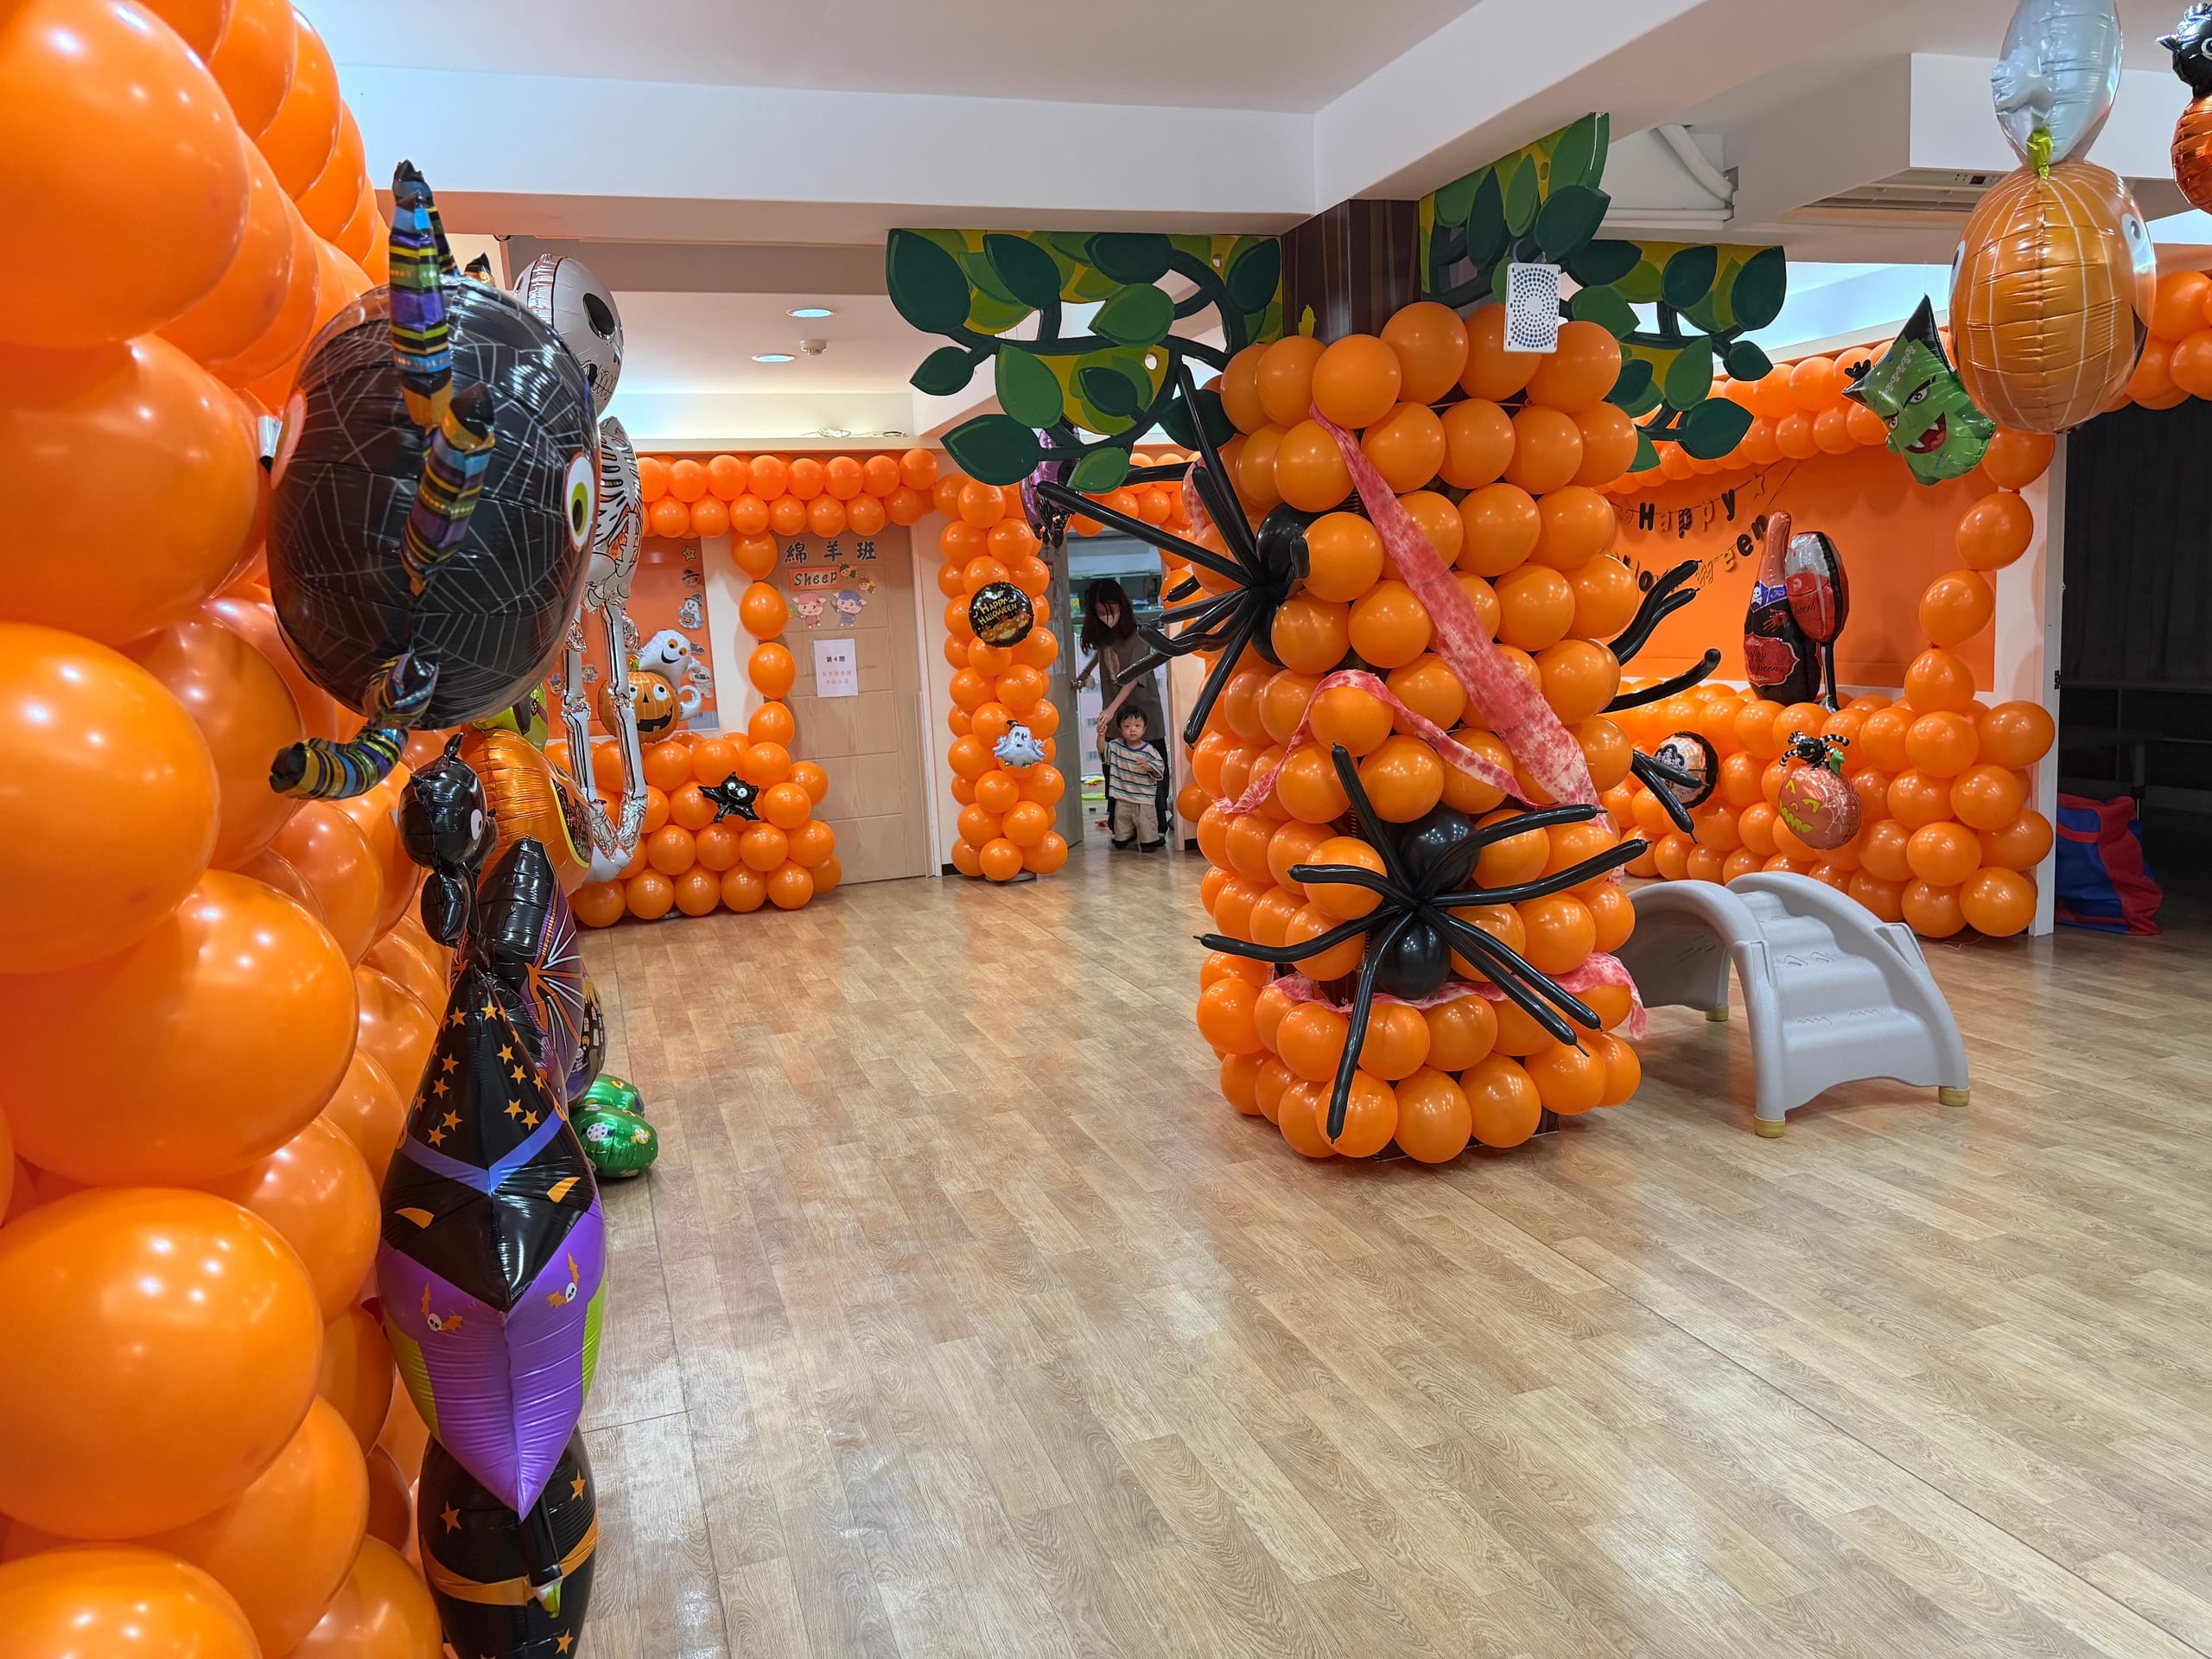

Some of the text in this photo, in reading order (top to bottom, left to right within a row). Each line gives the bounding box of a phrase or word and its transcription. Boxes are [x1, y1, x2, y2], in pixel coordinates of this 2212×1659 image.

[1639, 488, 1736, 538] Happy
[784, 539, 877, 563] 綿羊班
[794, 571, 837, 586] Sheep
